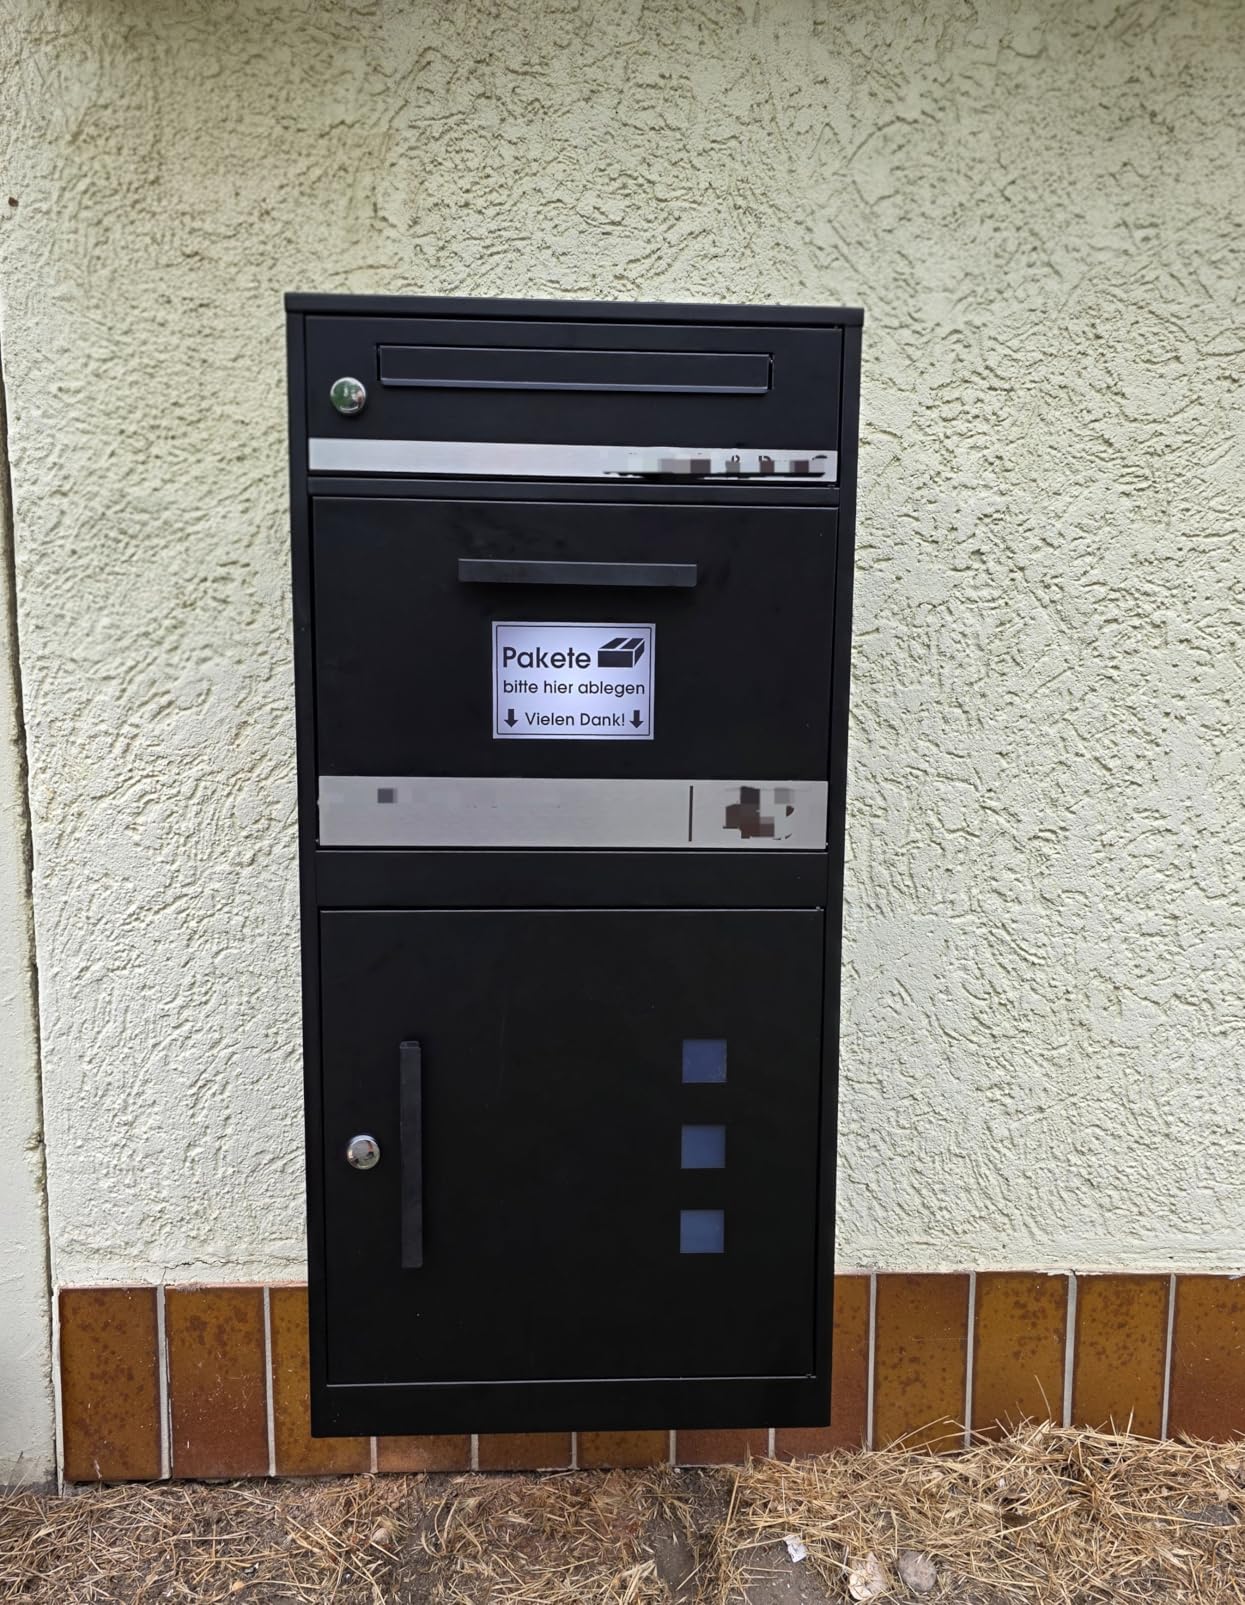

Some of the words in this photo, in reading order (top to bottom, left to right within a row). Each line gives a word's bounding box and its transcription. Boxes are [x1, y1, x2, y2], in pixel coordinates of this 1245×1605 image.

[502, 646, 591, 669] Pakete
[503, 679, 539, 694] bitte
[543, 680, 574, 694] hier
[578, 680, 645, 698] ablegen
[524, 712, 575, 726] Vielen
[580, 712, 625, 727] Dank!
